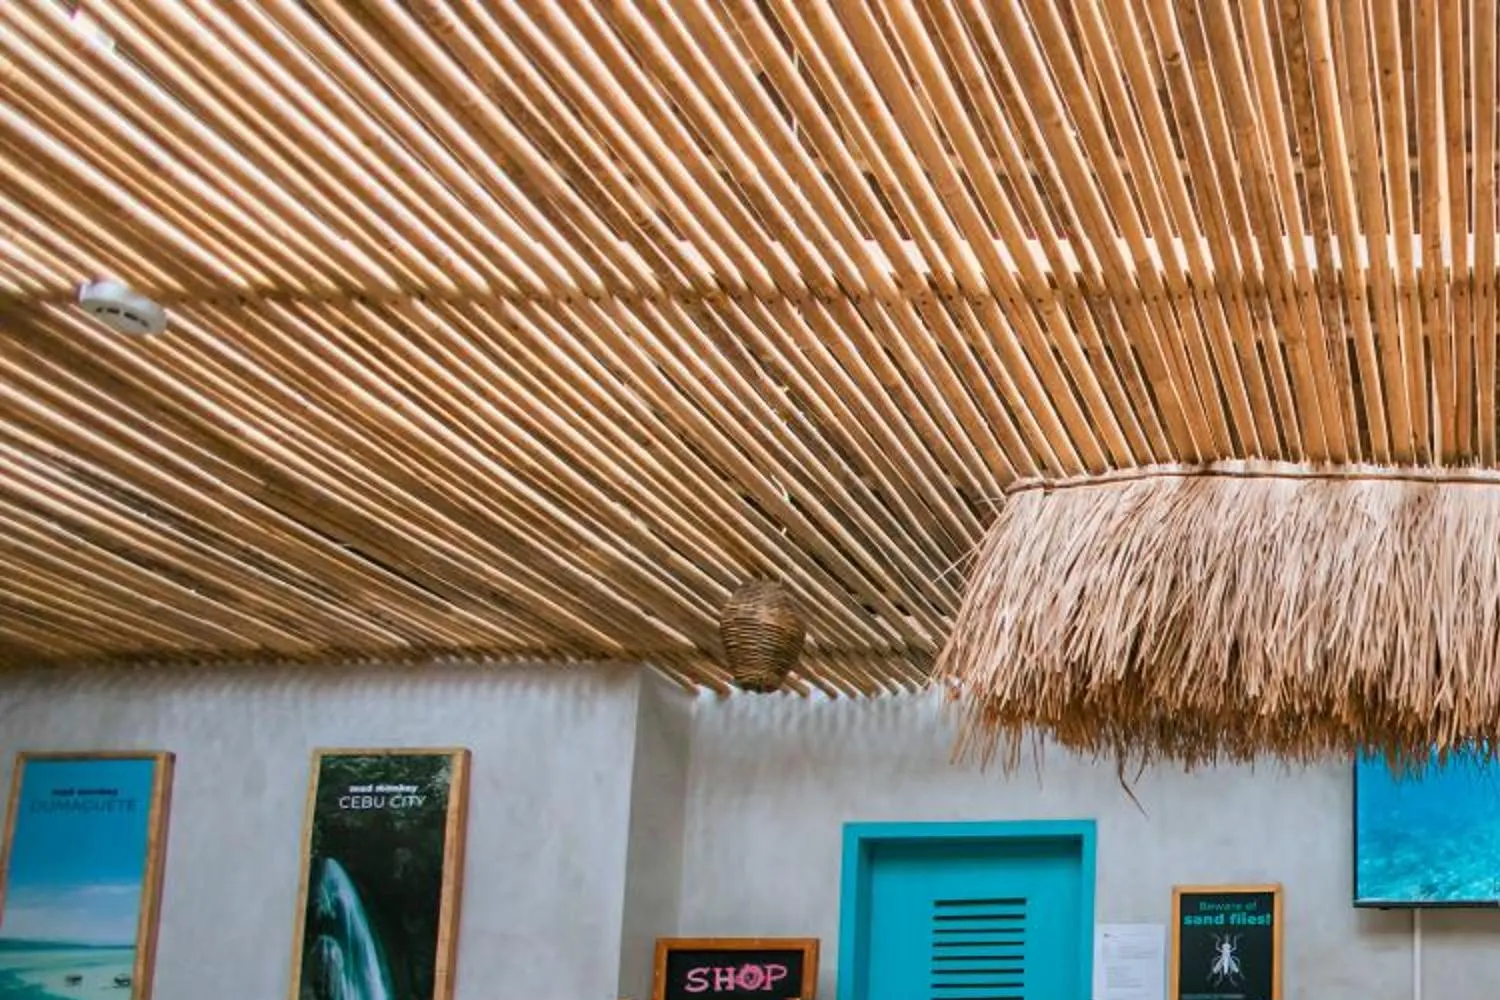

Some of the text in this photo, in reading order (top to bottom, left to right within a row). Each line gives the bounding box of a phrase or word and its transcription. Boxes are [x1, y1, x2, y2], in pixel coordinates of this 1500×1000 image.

[339, 796, 427, 809] CEBU CITY
[1184, 912, 1271, 925] sand flies!
[684, 964, 788, 992] SHOP
